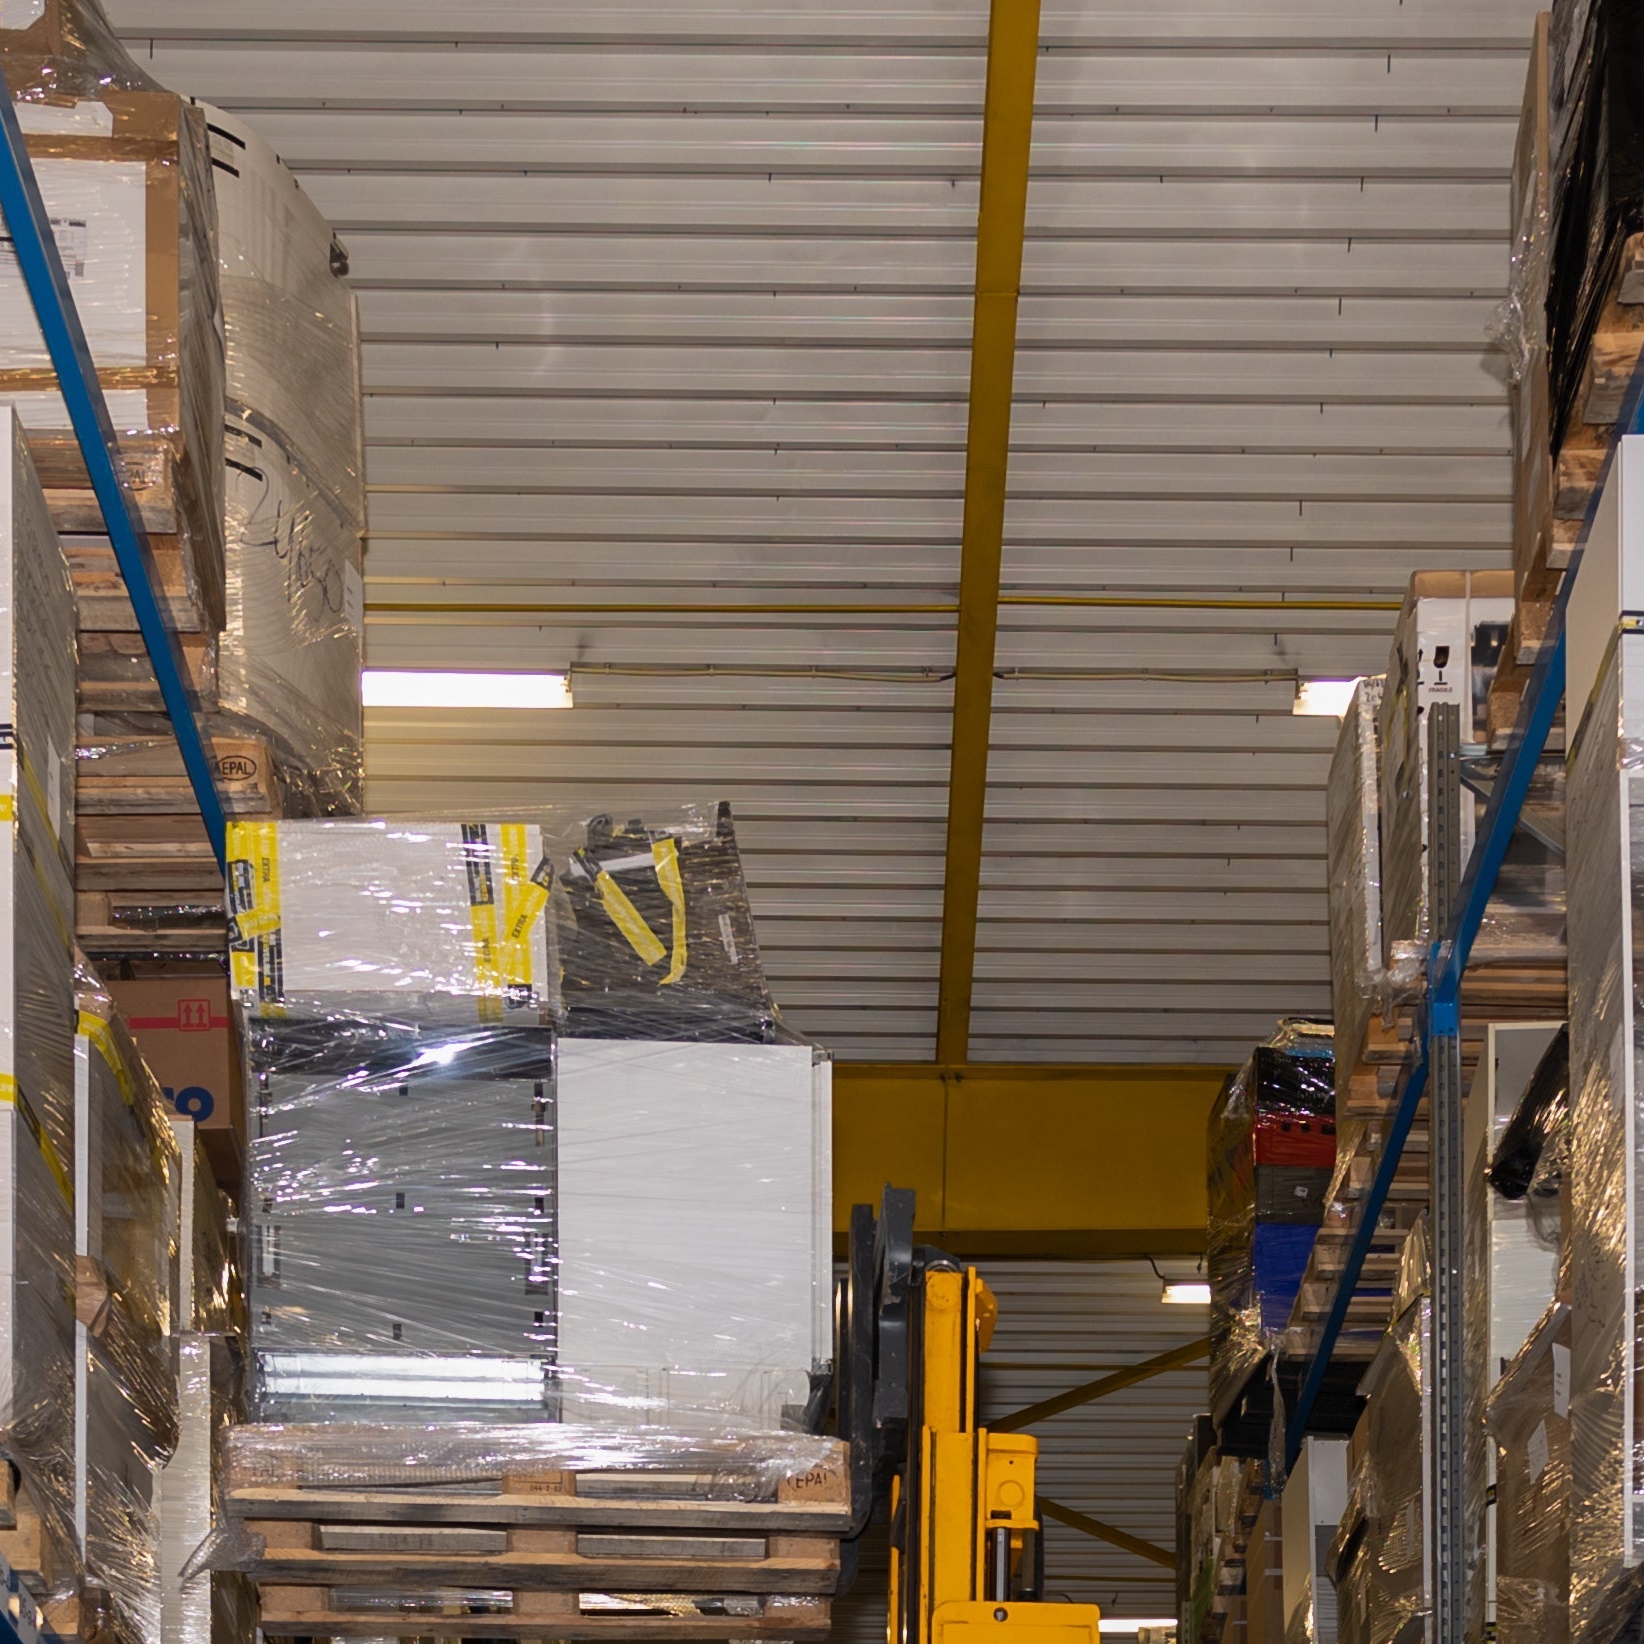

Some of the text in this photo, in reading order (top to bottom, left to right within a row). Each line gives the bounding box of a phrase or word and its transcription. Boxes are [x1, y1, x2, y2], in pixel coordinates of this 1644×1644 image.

[221, 761, 252, 776] EPAL
[260, 855, 272, 884] EXTRA
[511, 914, 529, 940] EXTRA
